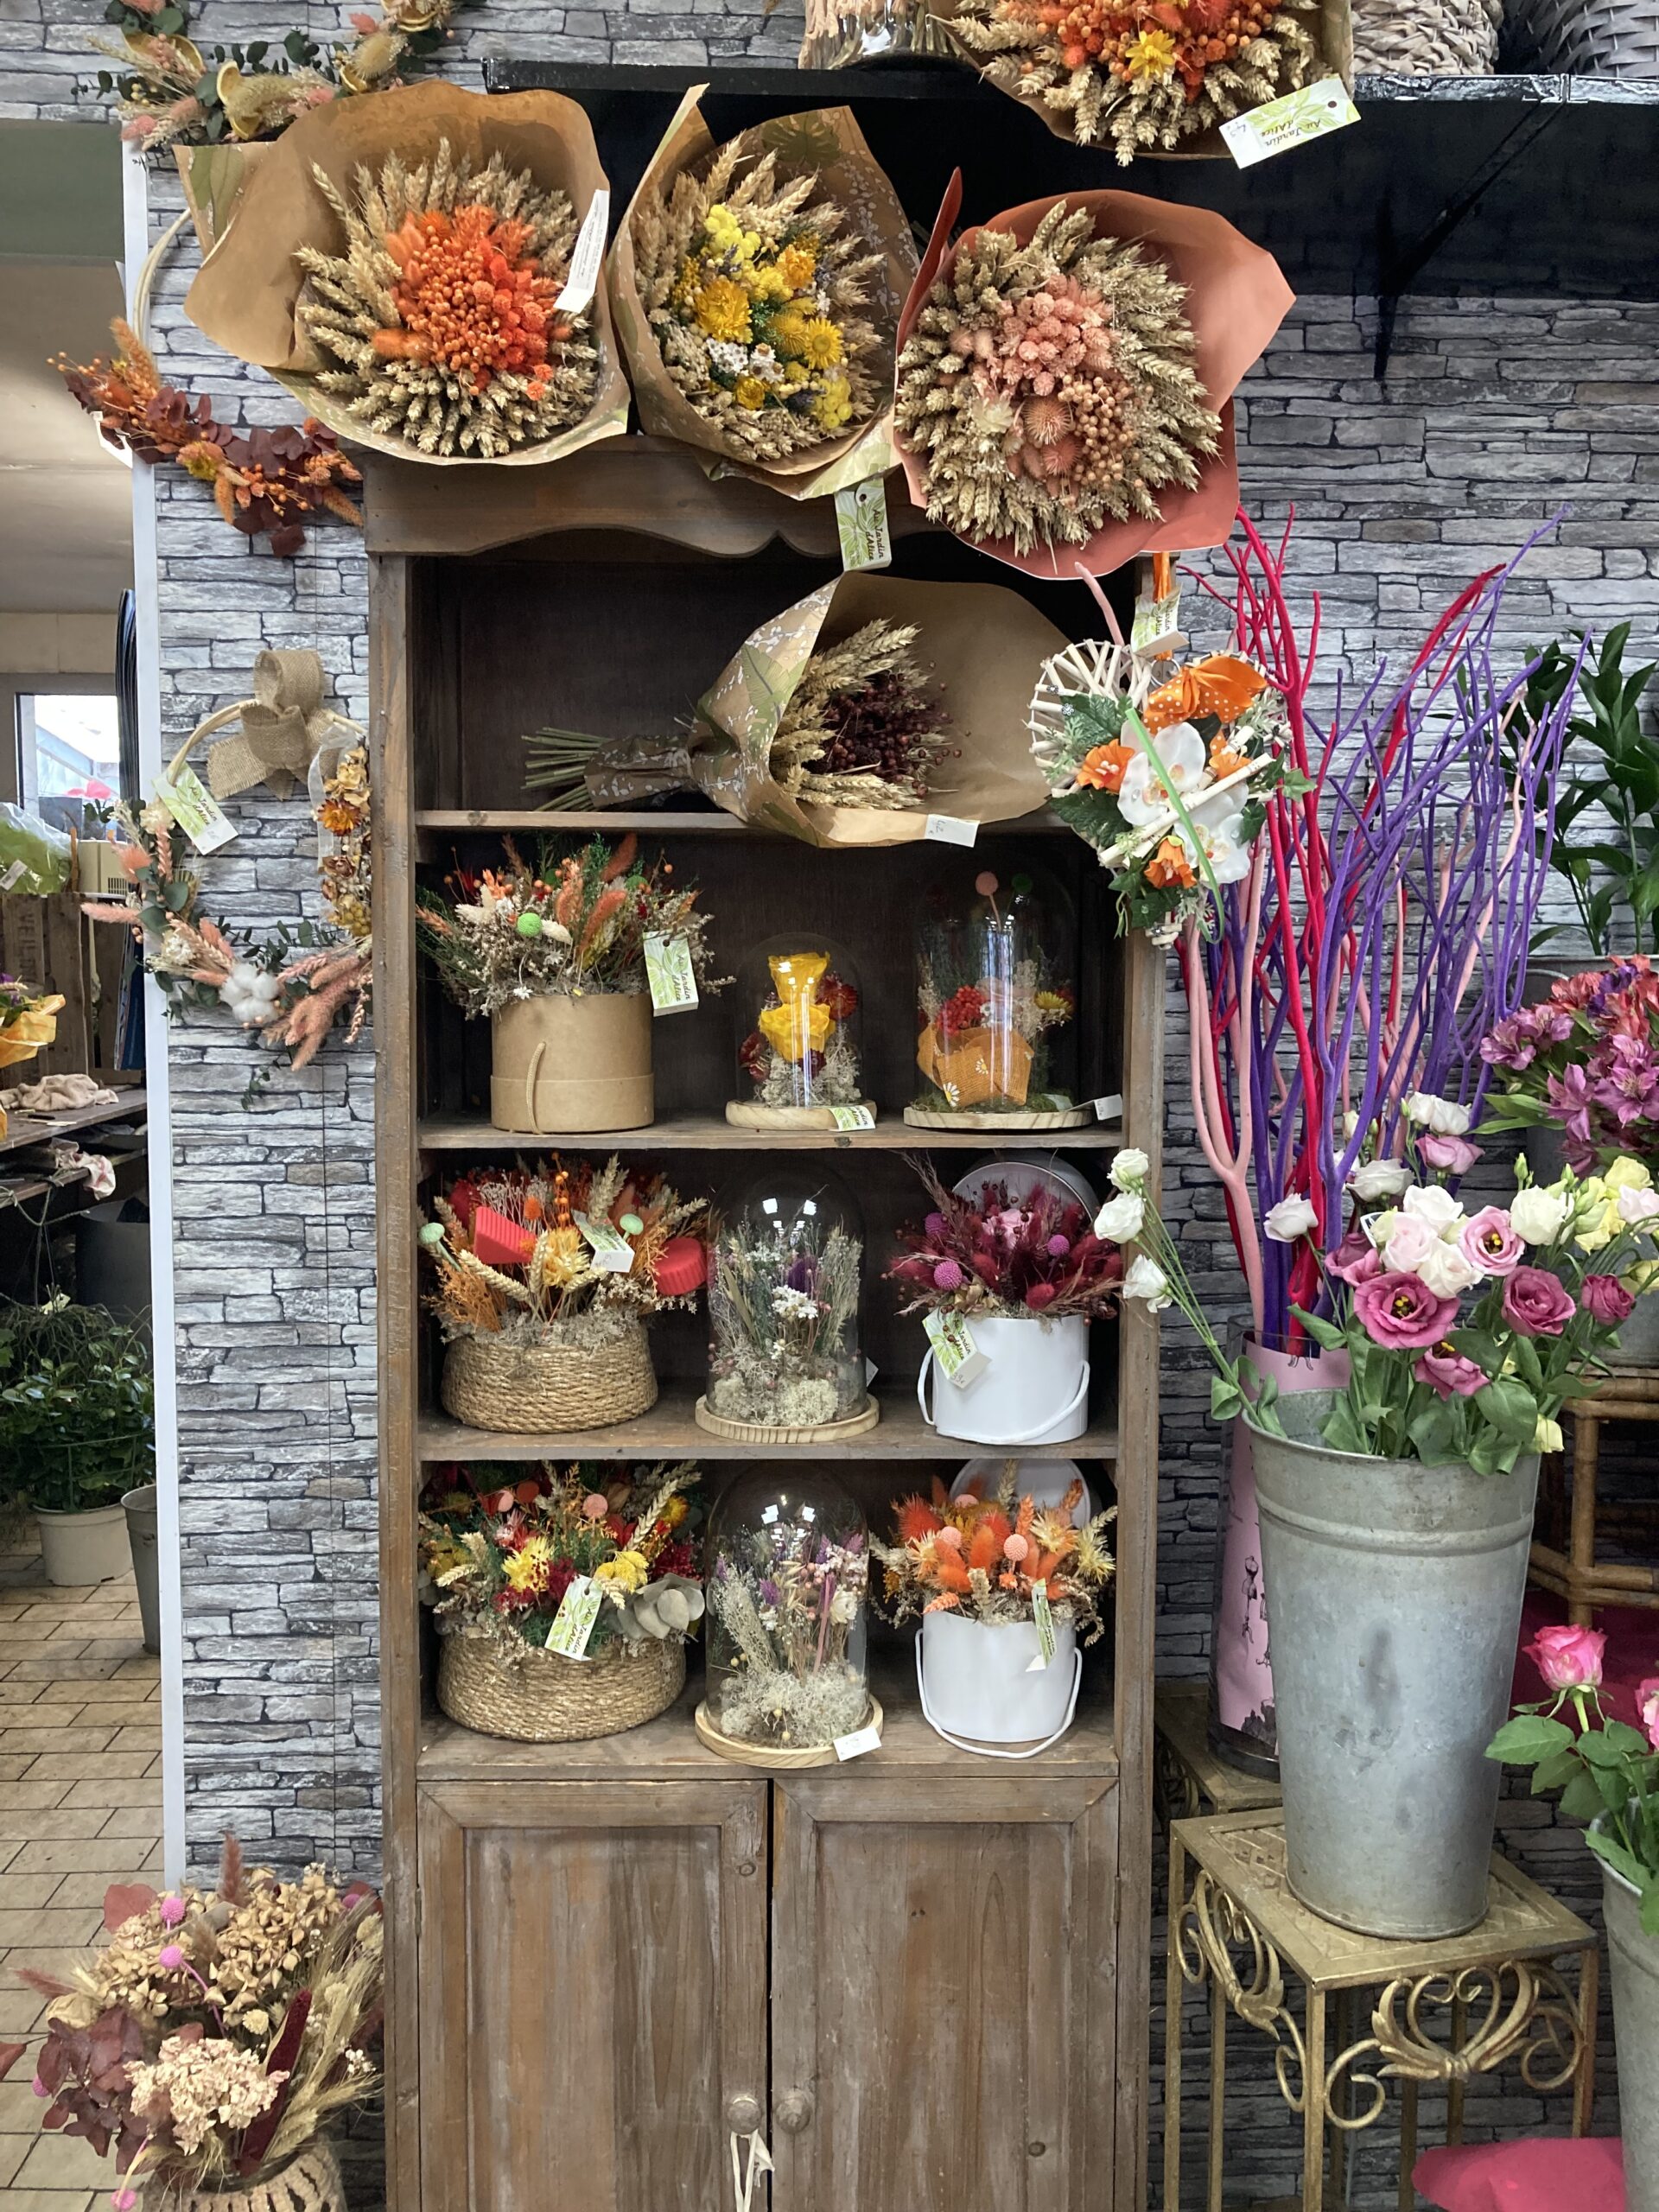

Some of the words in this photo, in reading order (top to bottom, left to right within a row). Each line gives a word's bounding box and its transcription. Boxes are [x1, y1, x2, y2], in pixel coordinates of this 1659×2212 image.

[1266, 127, 1302, 146] Jardin
[1303, 119, 1321, 130] Au
[873, 508, 881, 524] Au
[874, 525, 886, 558] Jardin
[189, 786, 200, 797] Au
[198, 798, 218, 822] Jardin
[677, 954, 685, 967] Au
[681, 970, 691, 1000] Jardin
[958, 1331, 971, 1355] Jardin
[584, 1608, 593, 1622] Au
[572, 1624, 588, 1654] Jardin
